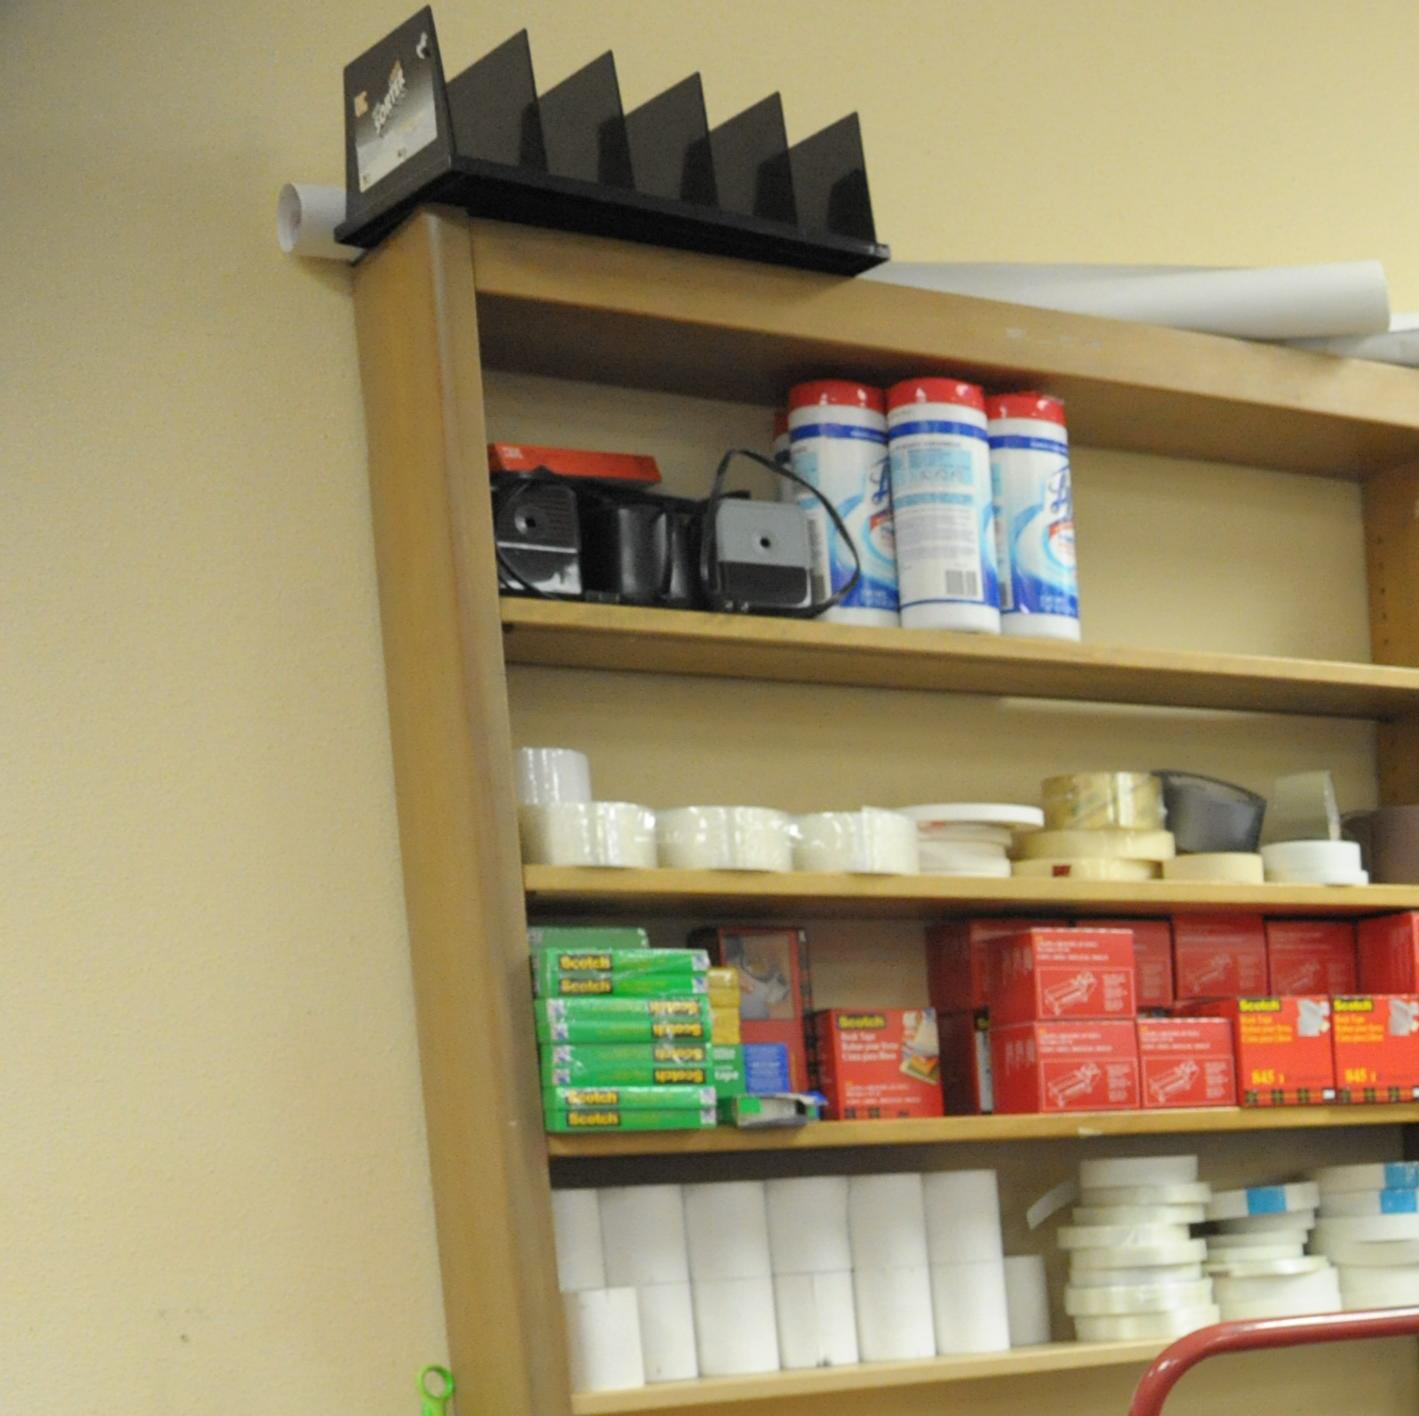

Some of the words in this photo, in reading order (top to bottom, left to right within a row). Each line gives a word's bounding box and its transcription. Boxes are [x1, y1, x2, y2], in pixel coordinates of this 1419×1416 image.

[560, 956, 611, 969] Scotch
[560, 980, 611, 993] Scotch
[648, 1001, 701, 1014] Scotch
[1240, 1000, 1281, 1011] Scotch
[1334, 1000, 1373, 1011] Scotch
[839, 1017, 885, 1028] Scotch
[653, 1023, 702, 1037] Scotch
[654, 1048, 704, 1060] Scotch
[654, 1069, 705, 1082] Scotch
[1251, 1069, 1274, 1084] 845
[1345, 1068, 1367, 1083] 845
[566, 1092, 617, 1104] Scotch
[568, 1112, 619, 1125] Scotch
